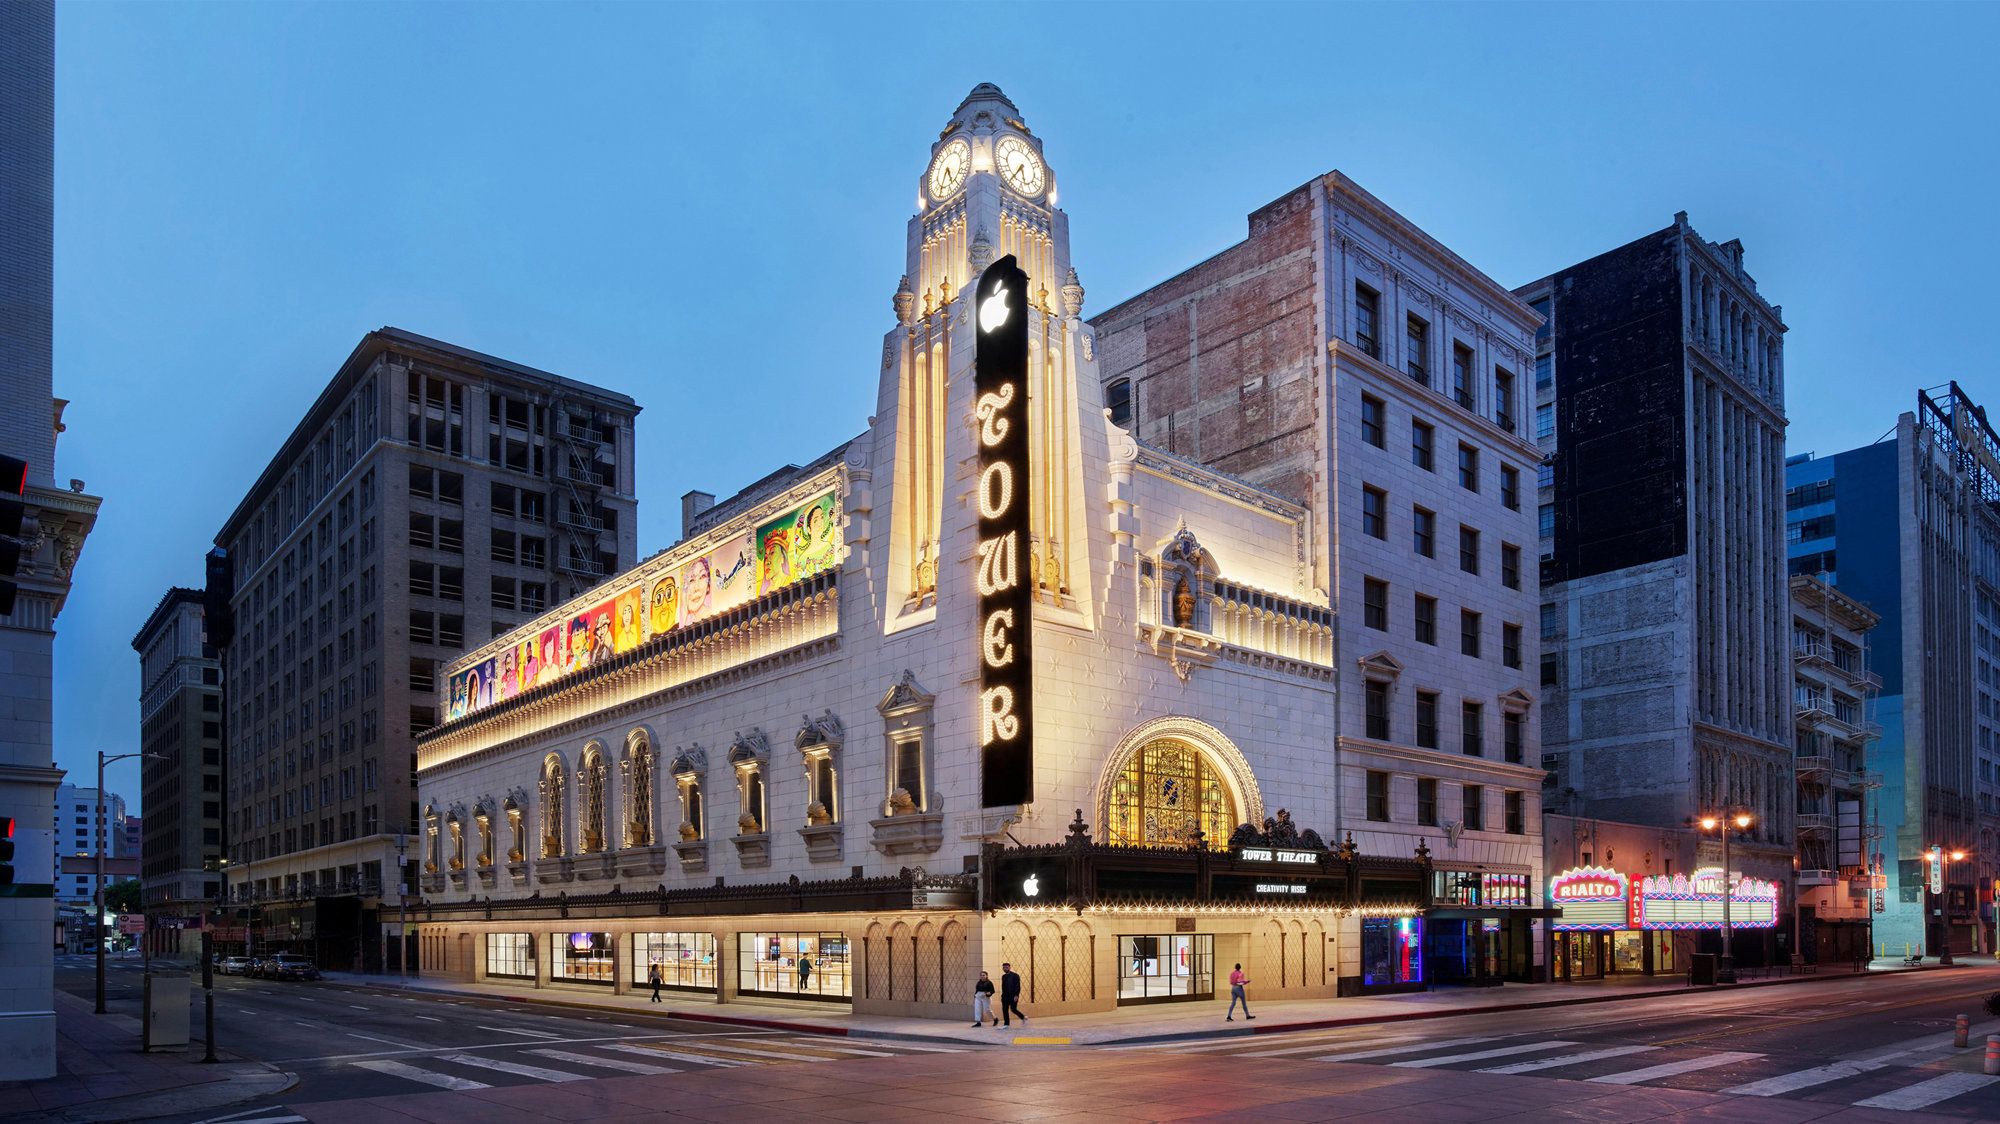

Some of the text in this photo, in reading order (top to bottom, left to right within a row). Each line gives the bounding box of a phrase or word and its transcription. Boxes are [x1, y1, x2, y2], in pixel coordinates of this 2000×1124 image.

[976, 383, 1018, 746] TOWER
[1242, 850, 1317, 863] TOWER THEATRE
[1256, 884, 1289, 893] CREATIVITY
[1560, 883, 1616, 897] RIALTO
[1633, 881, 1641, 923] RIALTO
[158, 917, 190, 926] Broadway
